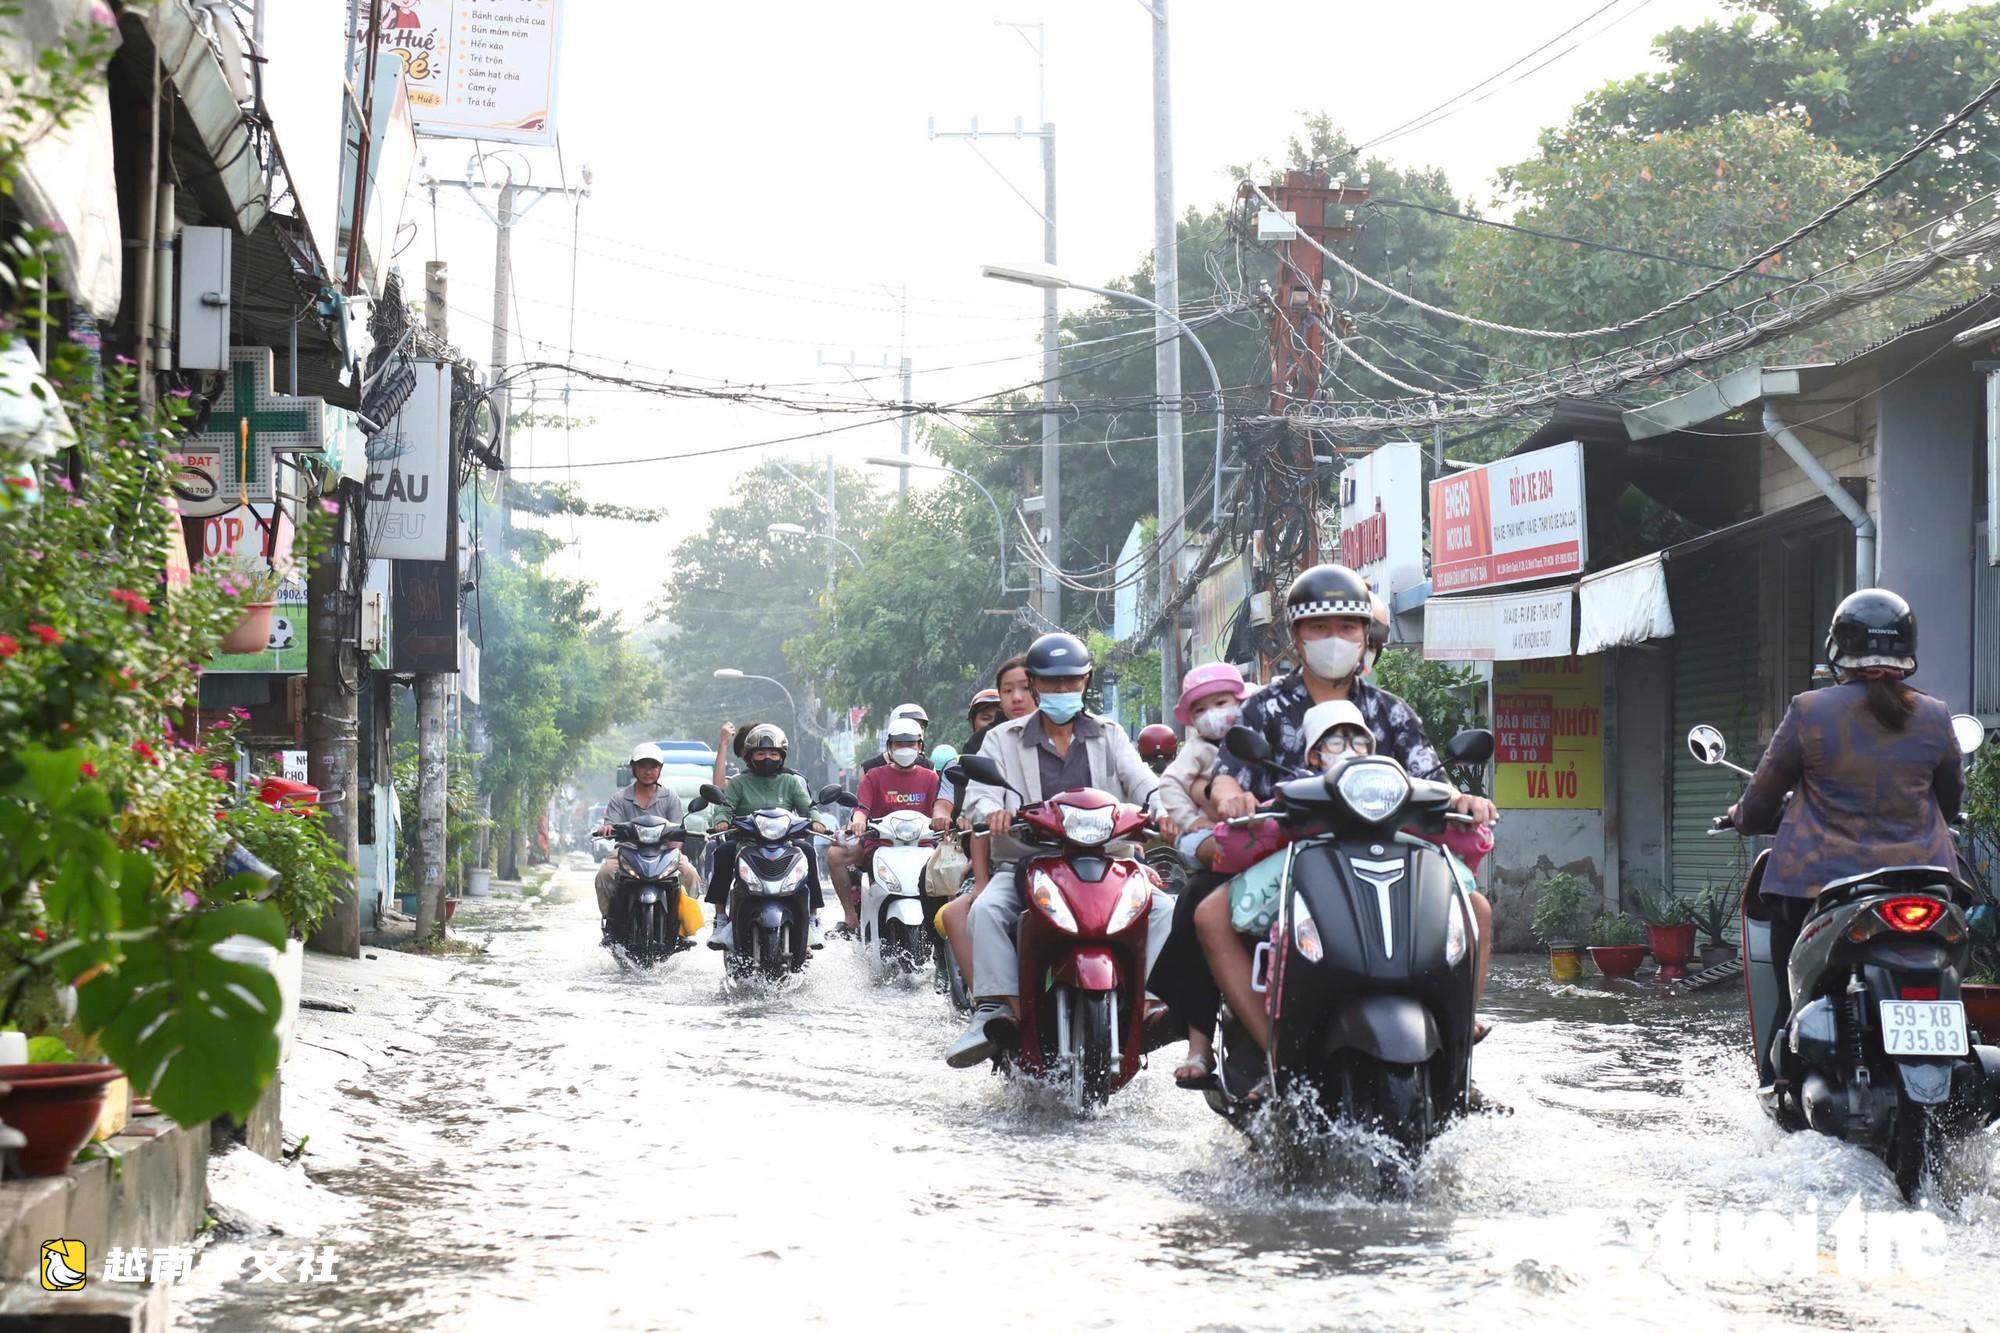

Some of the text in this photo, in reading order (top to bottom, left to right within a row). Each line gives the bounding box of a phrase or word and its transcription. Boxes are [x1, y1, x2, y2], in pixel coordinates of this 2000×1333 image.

[472, 10, 492, 20] Bánh
[494, 13, 513, 22] canh
[531, 18, 546, 26] cua
[394, 27, 436, 51] Huế
[467, 82, 486, 92] Cam
[503, 72, 520, 81] chia
[1526, 472, 1538, 503] XE
[1538, 469, 1554, 501] 284
[1444, 480, 1471, 521] ENEOS
[1446, 524, 1473, 552] MOTOR OIL
[1496, 709, 1519, 729] BẢO
[1501, 730, 1546, 747] XE MÁY
[1526, 761, 1577, 800] VÁ VỎ
[1892, 1004, 1952, 1028] 59-XB
[1889, 1028, 1960, 1052] 735.83
